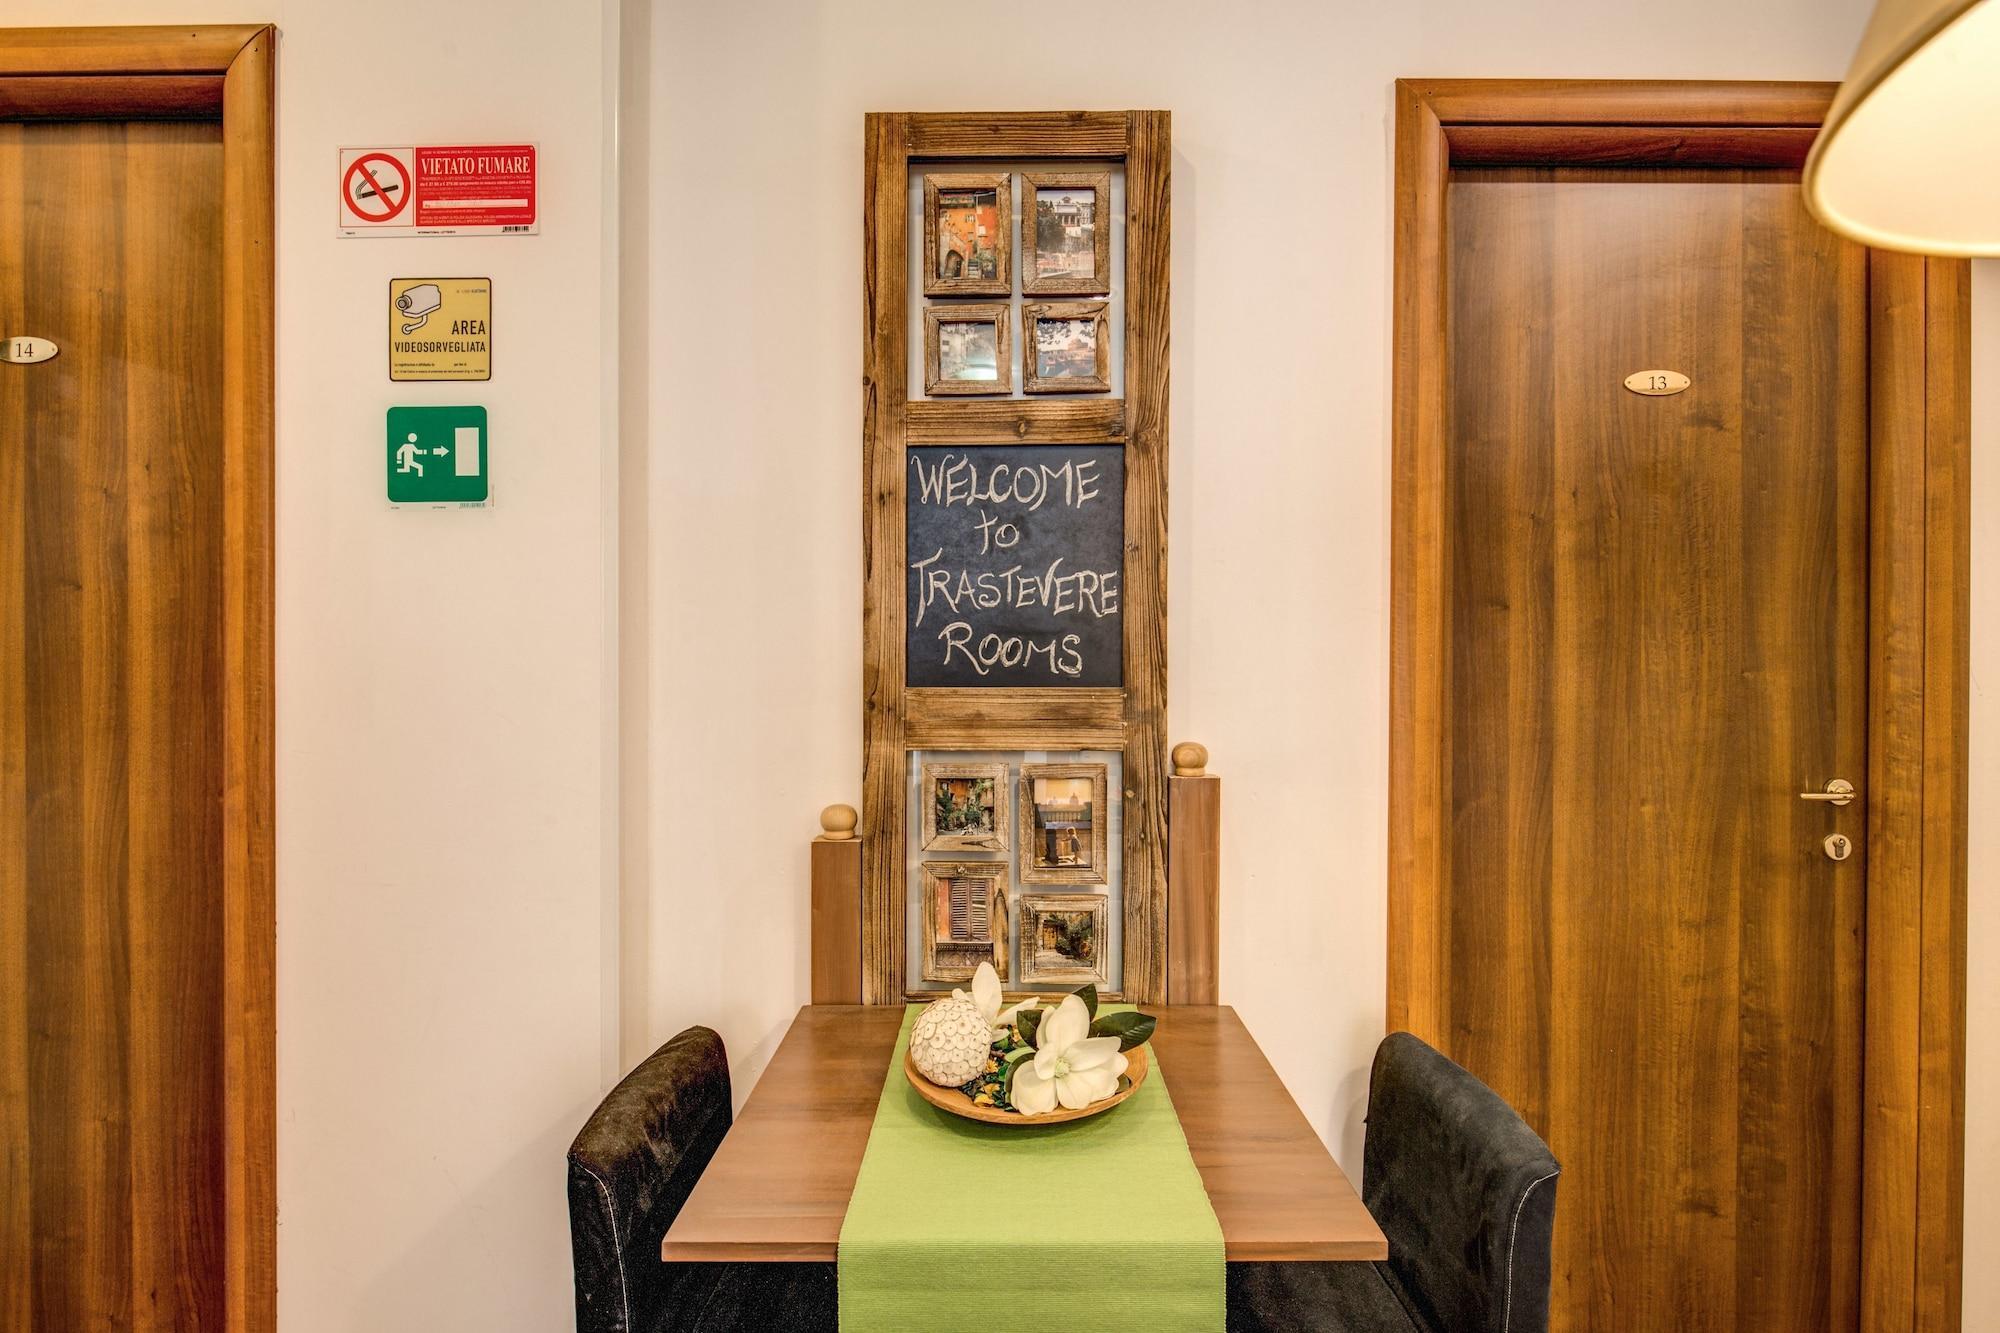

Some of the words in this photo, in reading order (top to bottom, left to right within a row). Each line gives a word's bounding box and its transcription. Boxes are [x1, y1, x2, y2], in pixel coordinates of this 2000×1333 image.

[421, 157, 475, 175] VIETATO
[478, 156, 531, 174] FUMARE
[451, 320, 486, 335] AREA
[16, 343, 34, 358] 14
[394, 341, 486, 353] VIDEOSORVEGLIATA
[1648, 375, 1667, 391] 13
[911, 453, 1100, 511] WELCOME
[974, 509, 1020, 555] to
[911, 547, 1118, 628] TRASTEVERE
[938, 621, 1082, 676] ROOMS
